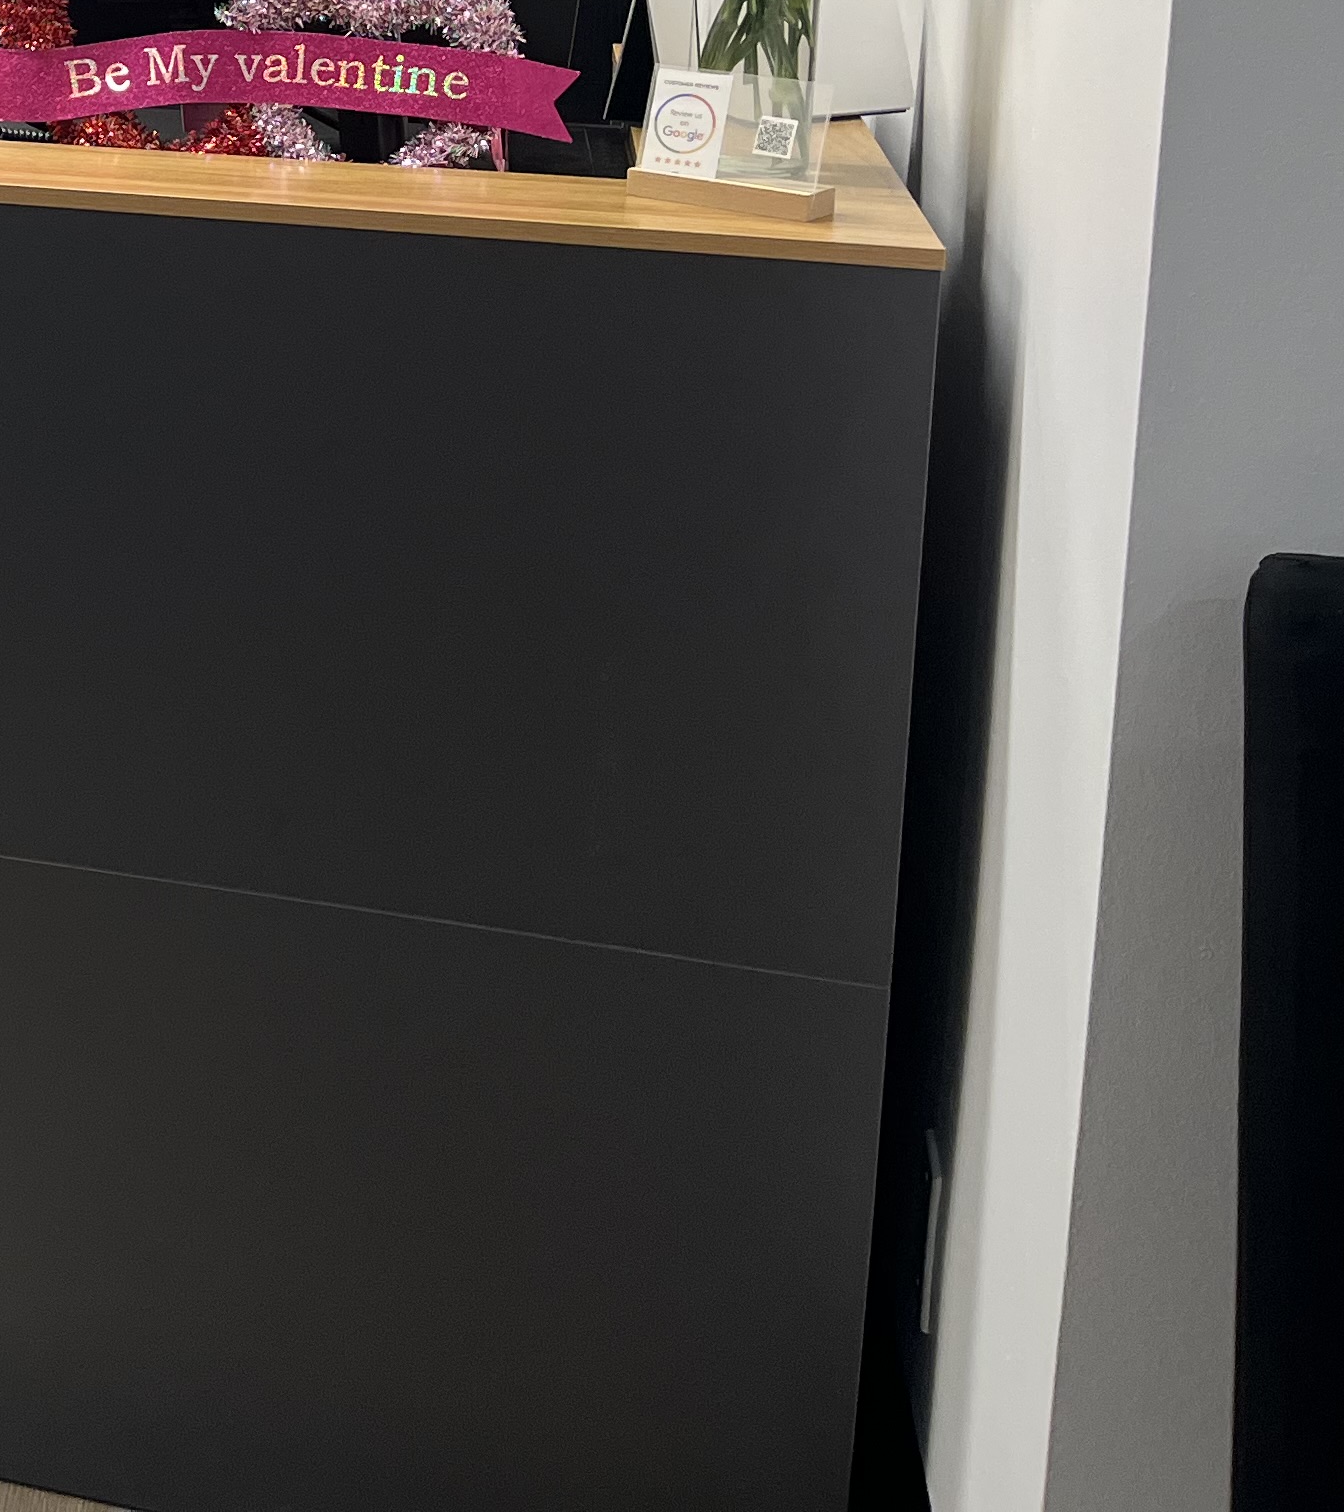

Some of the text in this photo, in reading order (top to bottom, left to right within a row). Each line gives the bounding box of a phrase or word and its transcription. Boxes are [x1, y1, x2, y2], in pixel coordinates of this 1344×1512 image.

[64, 43, 470, 100] Be My valentine
[670, 109, 693, 117] Review
[663, 125, 704, 142] Google
